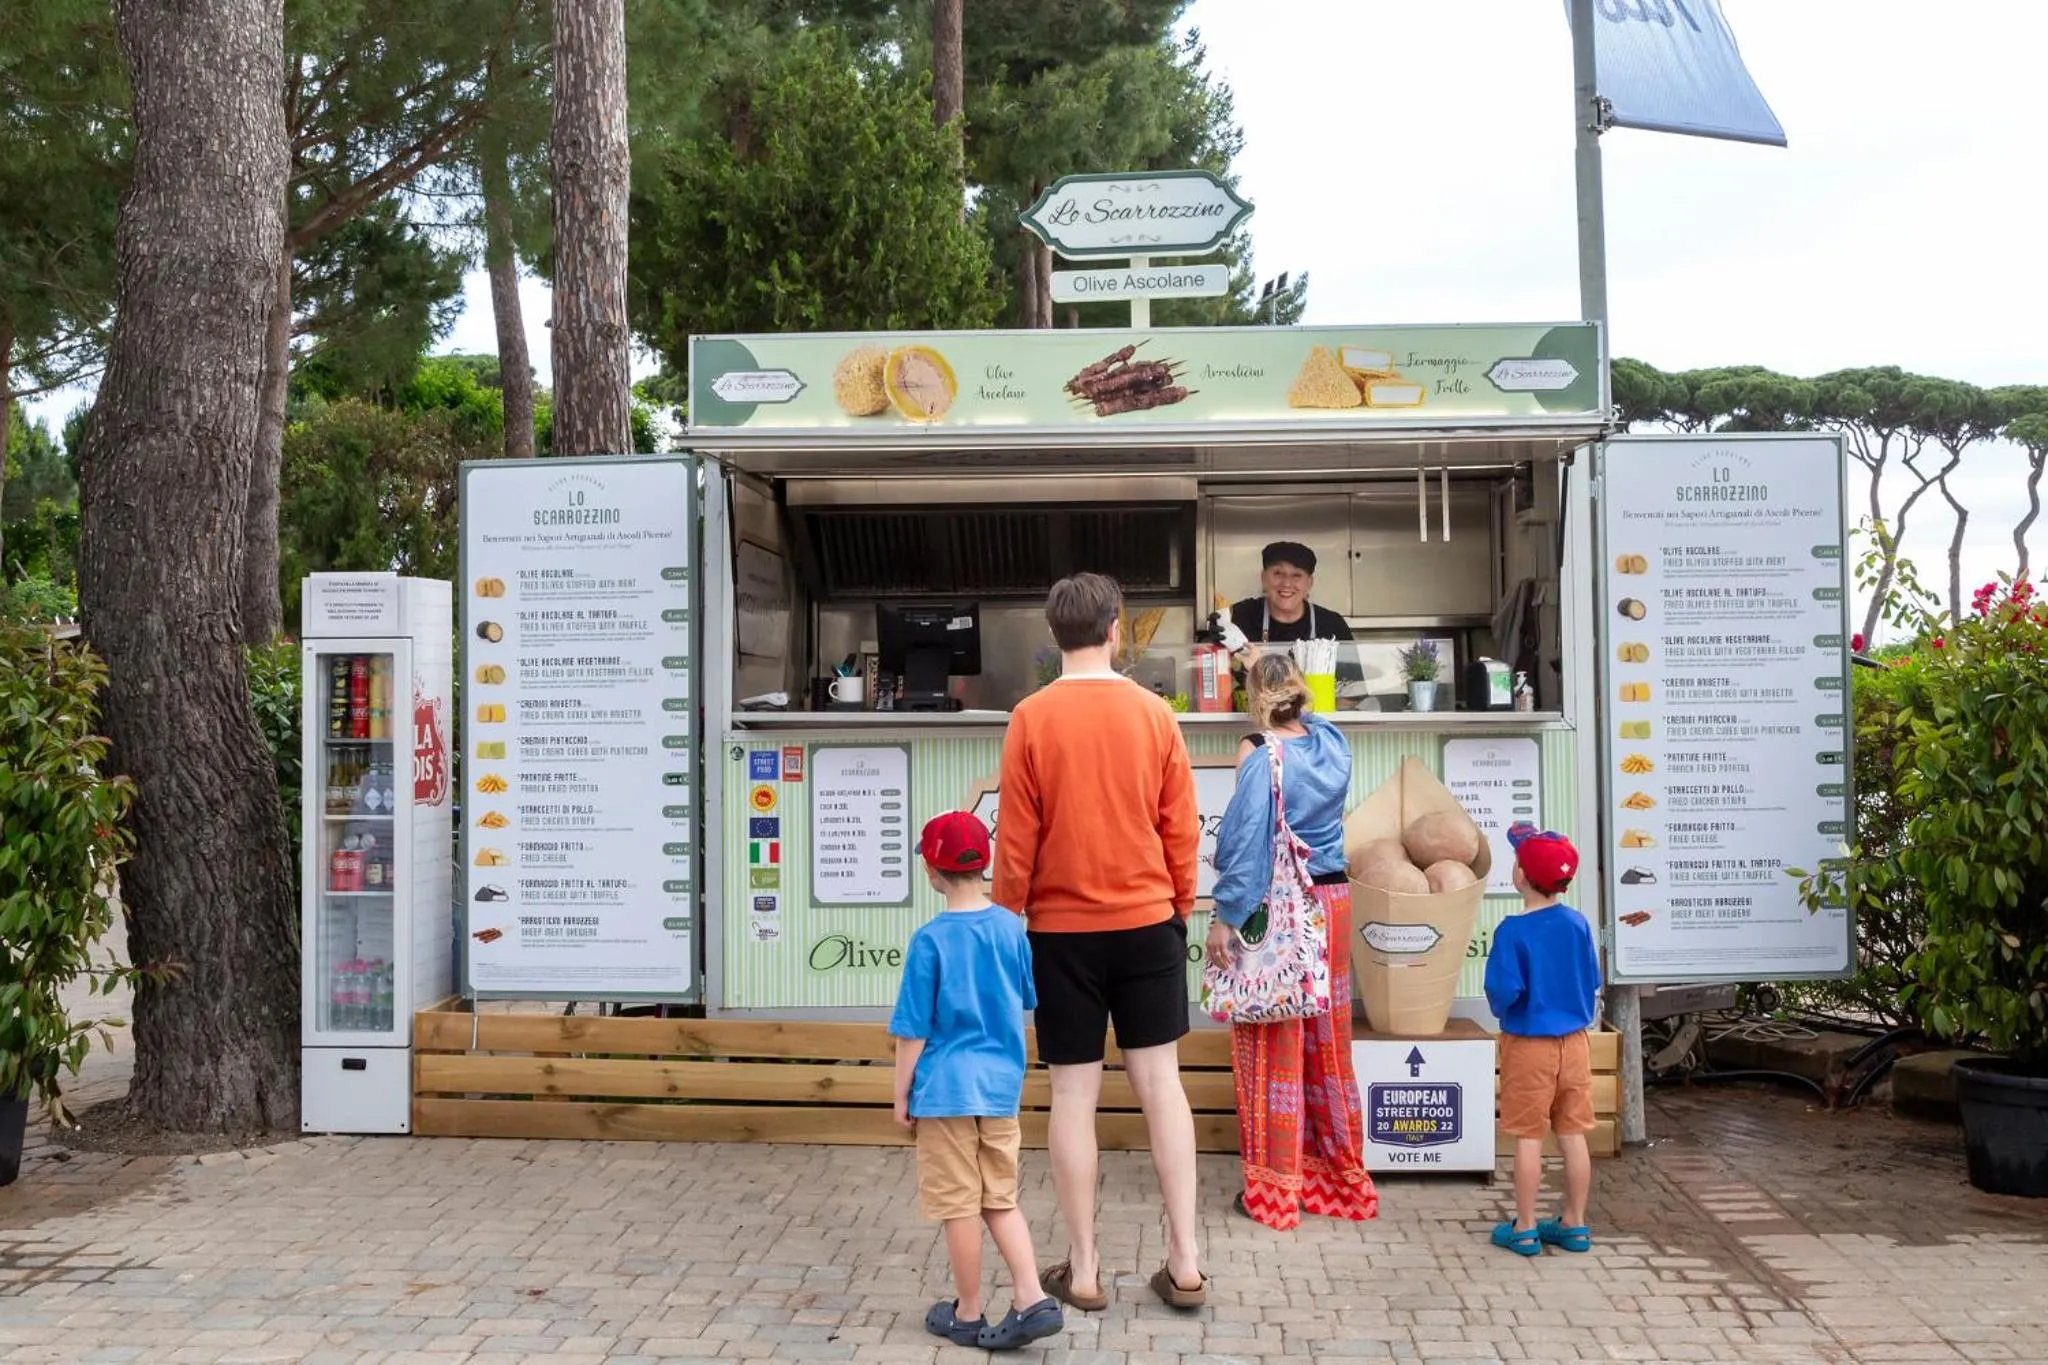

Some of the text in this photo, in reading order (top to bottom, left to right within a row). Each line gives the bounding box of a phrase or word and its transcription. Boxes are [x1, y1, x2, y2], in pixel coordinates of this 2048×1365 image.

[1048, 198, 1224, 226] Lo Scarrozzino
[1073, 272, 1205, 292] Olive Ascolane
[1713, 467, 1730, 483] LO
[569, 490, 584, 507] LO
[1676, 485, 1767, 502] SCARROZZINO
[534, 508, 620, 526] SCARROZZINO
[808, 934, 901, 972] Olive
[1383, 1089, 1447, 1105] EUROPEAN
[1376, 1107, 1453, 1117] STREET FOOD
[1377, 1120, 1453, 1132] 20 AWARDS 22
[1405, 1134, 1424, 1142] ITALY
[1388, 1153, 1442, 1163] VOTE ME
